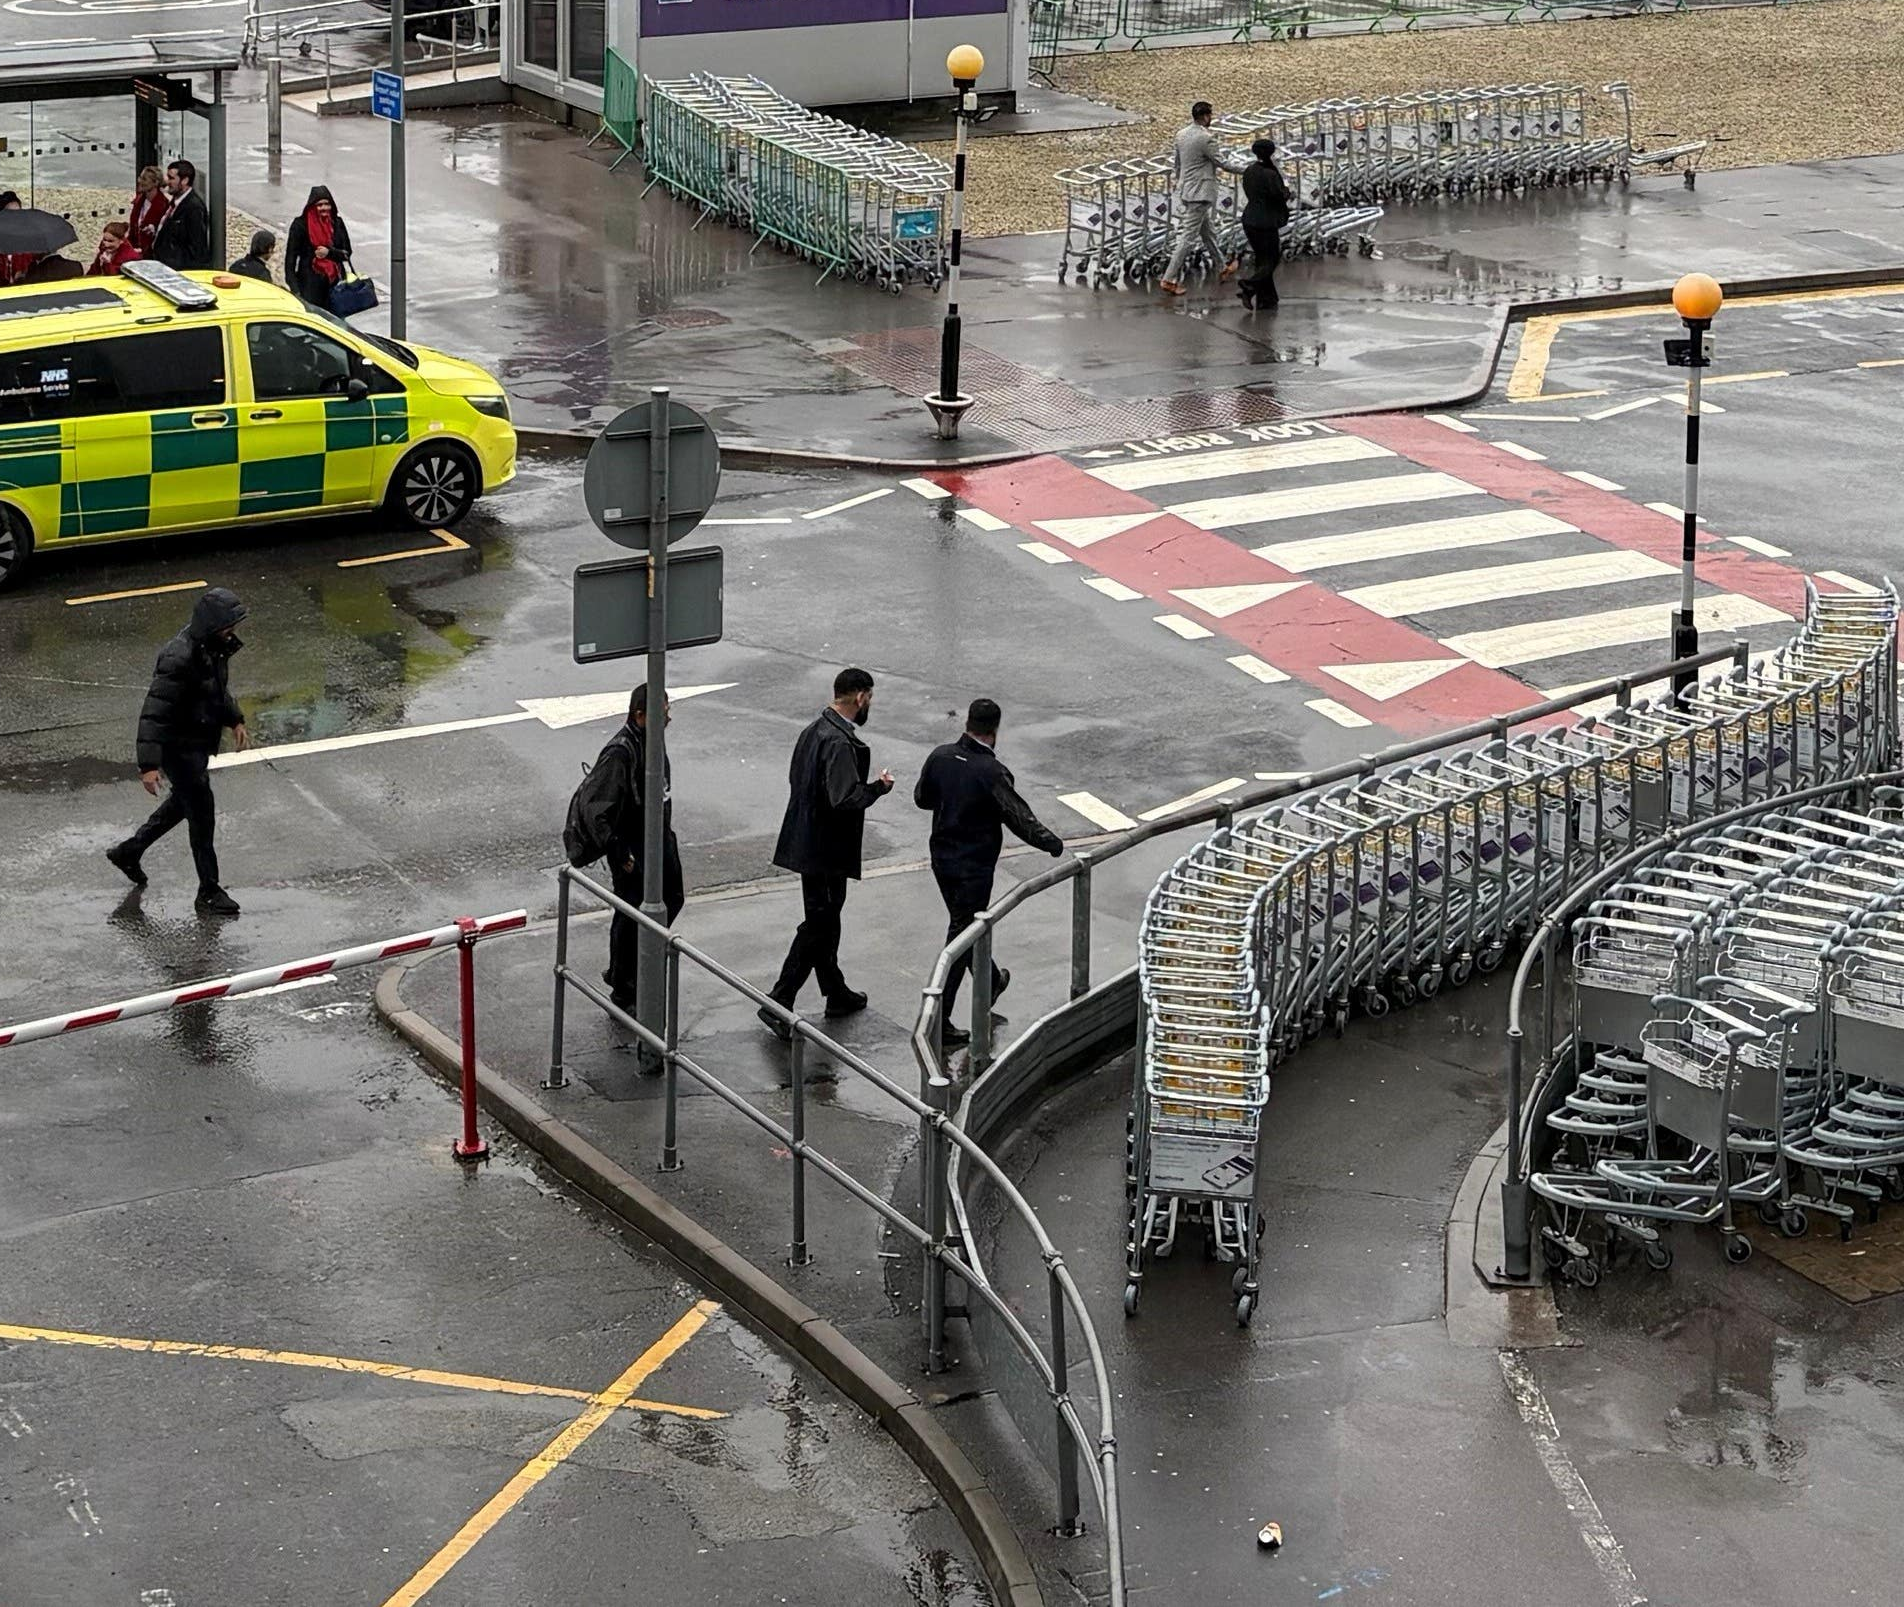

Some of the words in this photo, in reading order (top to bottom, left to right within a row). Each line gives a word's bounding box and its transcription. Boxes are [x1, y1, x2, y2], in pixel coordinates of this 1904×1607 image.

[40, 368, 69, 383] NHS
[1233, 421, 1340, 442] LOOK
[1123, 431, 1234, 457] RIGHT
